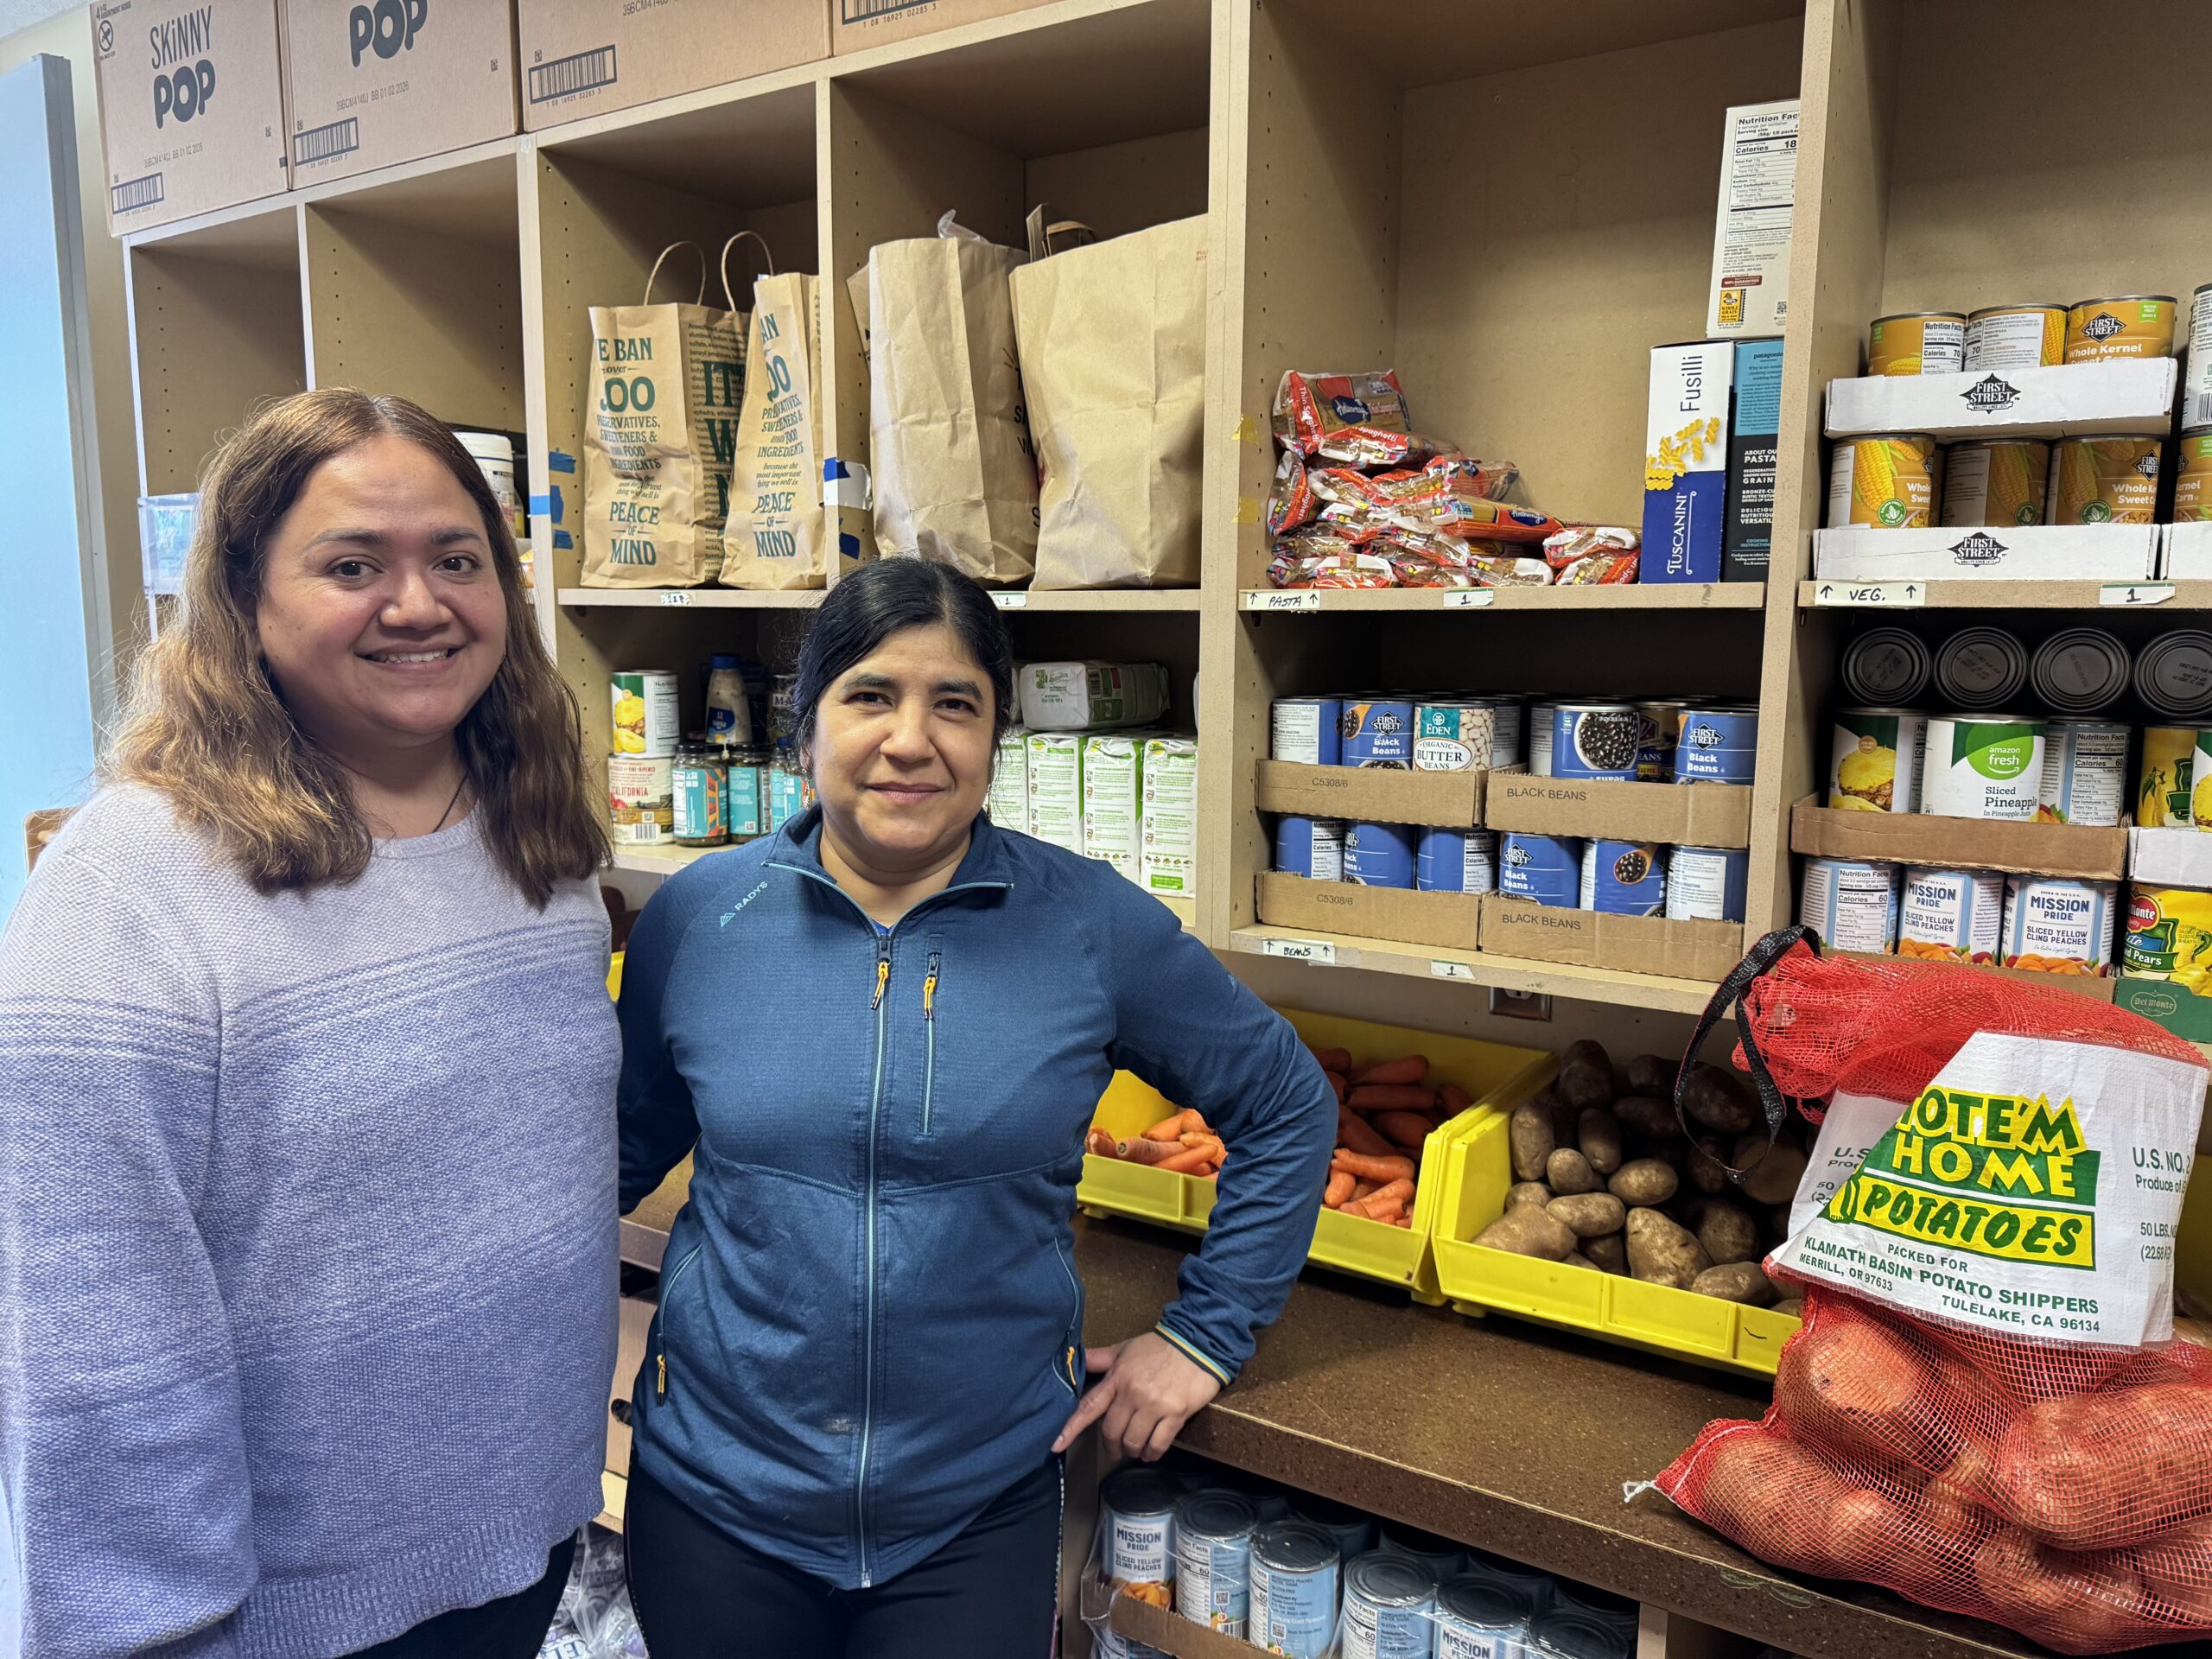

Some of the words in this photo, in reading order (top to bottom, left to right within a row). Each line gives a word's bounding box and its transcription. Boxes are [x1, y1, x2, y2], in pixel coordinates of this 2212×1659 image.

[350, 0, 427, 67] POP
[154, 59, 216, 129] POP
[1738, 115, 1778, 125] Nutrition
[1736, 145, 1769, 154] Calories
[2090, 318, 2117, 327] FIRST
[2085, 325, 2120, 337] STREET
[613, 337, 653, 361] BAN
[2069, 346, 2097, 359] Whole
[2100, 344, 2142, 354] Kernel
[1680, 355, 1703, 411] Fusilli
[1976, 382, 2008, 393] FIRST
[1970, 391, 2012, 403] STREET
[623, 446, 645, 456] FOOD
[2113, 483, 2146, 493] Whole
[752, 492, 796, 513] PEACE
[2118, 494, 2149, 505] Sweet
[609, 501, 660, 525] PEACE
[766, 517, 773, 527] OF
[628, 525, 637, 536] OF
[1667, 495, 1688, 574] TUSCANINI
[753, 531, 796, 557] MIND
[1964, 537, 1996, 548] FIRST
[610, 538, 657, 566] MIND
[1957, 547, 1999, 558] STREET
[1460, 595, 1471, 605] 1
[1849, 588, 1886, 601] VEG.
[2126, 588, 2141, 602] 1
[1269, 596, 1302, 607] PASTA
[1427, 723, 1451, 735] EDEN
[1692, 728, 1716, 738] FIRST
[1689, 735, 1719, 746] STREET
[1372, 747, 1401, 755] Beans
[1417, 749, 1464, 762] BUTTER
[1689, 753, 1717, 763] Black
[1988, 754, 2019, 766] fresh
[1688, 763, 1719, 773] Beans
[1312, 778, 1348, 788] C5308/6
[1507, 787, 1545, 798] BLACK
[1548, 790, 1587, 801] BEANS
[1986, 786, 2016, 796] Sliced
[1985, 796, 2037, 810] Pineapple
[1504, 854, 1529, 864] STREET
[1507, 848, 1525, 858] FIRST
[1504, 870, 1528, 880] Black
[1503, 879, 1529, 890] Beans
[734, 881, 768, 911] RADYS
[1908, 882, 1956, 900] MISSION
[1317, 893, 1353, 906] C5308/6
[1916, 897, 1941, 907] PRIDE
[2031, 895, 2089, 912] MISSION
[1503, 913, 1539, 925] BLACK
[1541, 916, 1581, 931] BEANS
[1905, 911, 1923, 921] SLICED
[1925, 915, 1955, 925] YELLOW
[2044, 911, 2074, 921] PRIDE
[1904, 918, 1919, 927] CLING
[1921, 921, 1954, 932] PEACHES
[2026, 925, 2053, 936] SLICED
[2056, 930, 2088, 938] YELLOW
[2026, 933, 2048, 943] CLING
[2051, 936, 2087, 945] PEACHES
[1283, 947, 1311, 957] BEANS
[2133, 950, 2162, 966] Pears
[1447, 966, 1457, 976] 1
[2134, 997, 2147, 1006] Del
[2148, 999, 2174, 1009] Monte
[1892, 1133, 2075, 1198] HOME
[2133, 1147, 2164, 1171] U.S.
[2165, 1151, 2184, 1173] NO.
[1817, 1181, 1834, 1190] 50
[2135, 1174, 2173, 1192] Produce
[1863, 1184, 2082, 1256] POTATOES
[2140, 1222, 2152, 1236] 50
[2154, 1223, 2171, 1238] LBS.
[1888, 1243, 1935, 1265] PACKED
[1941, 1257, 1968, 1273] FOR
[1799, 1253, 1845, 1277] MERRILL,
[1849, 1268, 1864, 1280] OR
[1865, 1271, 1893, 1292] 97633
[1804, 1236, 1866, 1264] KLAMATH
[1869, 1255, 1912, 1281] BASIN
[1919, 1270, 1993, 1299] POTATO
[1999, 1289, 2099, 1314] SHIPPERS
[1942, 1294, 2024, 1326] TULELAKE,
[2031, 1314, 2054, 1328] CA
[2060, 1318, 2100, 1332] 96134
[1116, 1528, 1161, 1543] MISSION
[1127, 1541, 1149, 1552] PRIDE
[1358, 1605, 1376, 1617] Facts
[1442, 1630, 1491, 1658] MISSION
